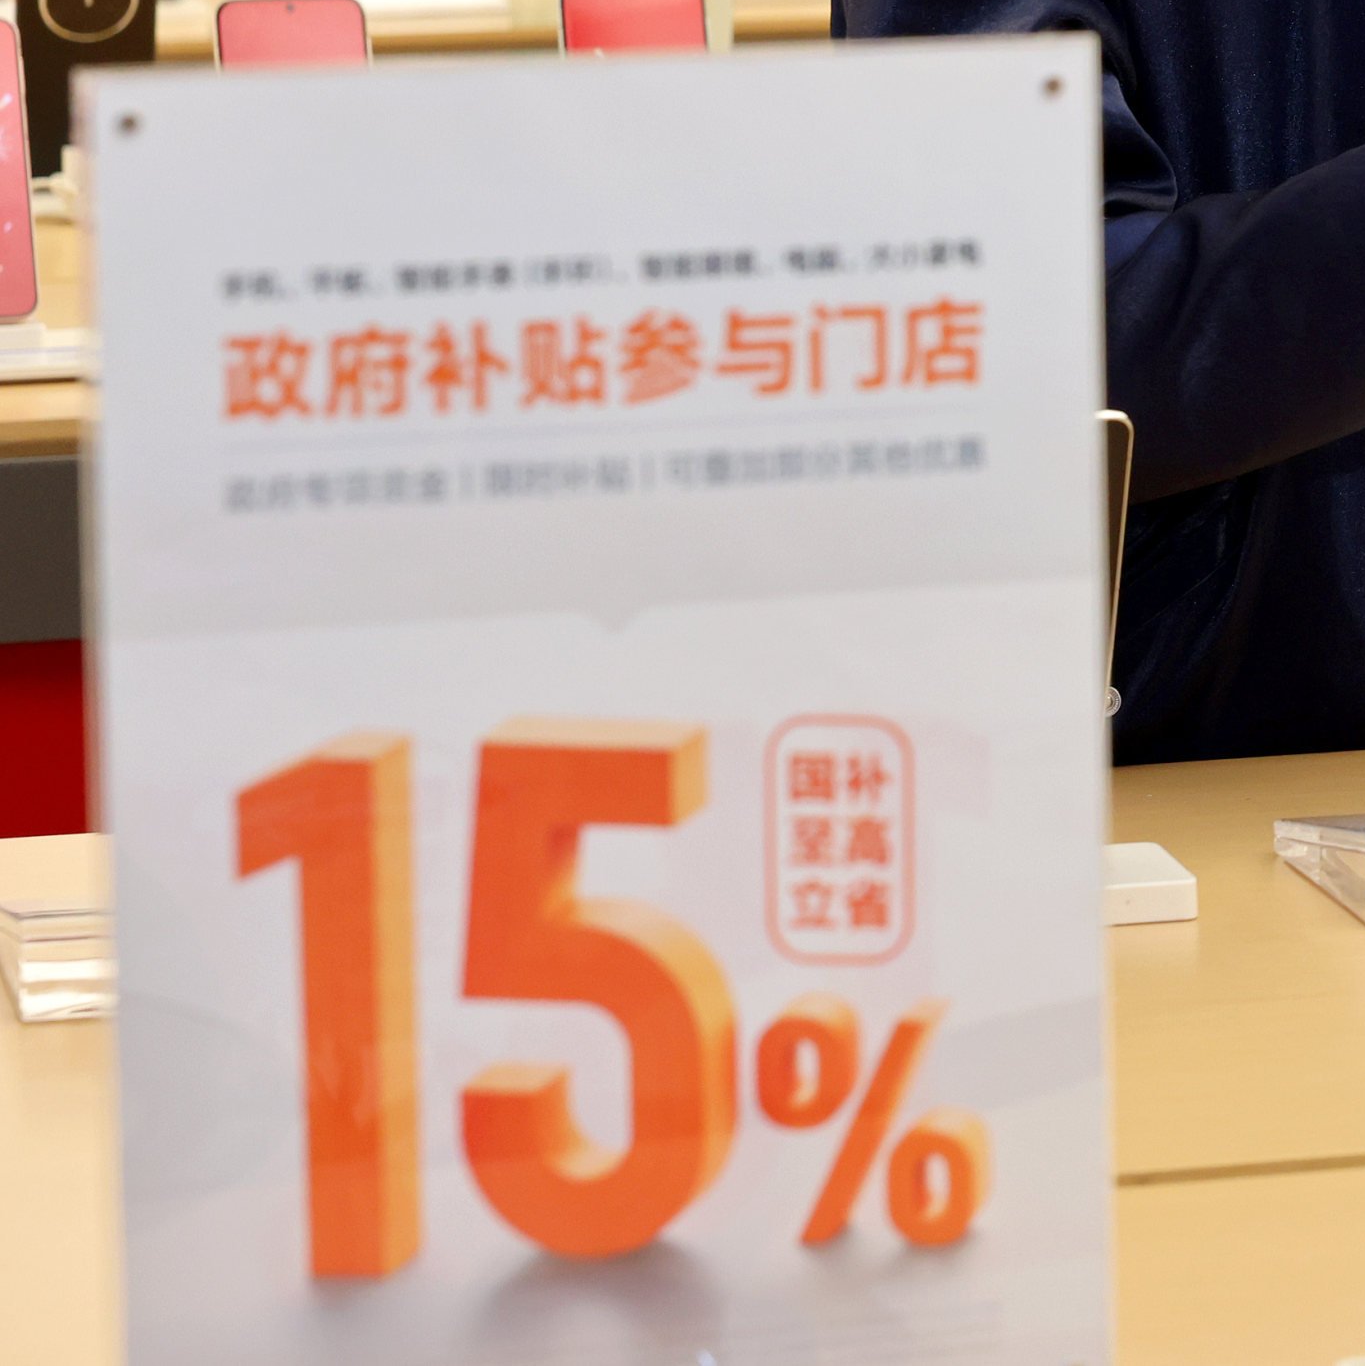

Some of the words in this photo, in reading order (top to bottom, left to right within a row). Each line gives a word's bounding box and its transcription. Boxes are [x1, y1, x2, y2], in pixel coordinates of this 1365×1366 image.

[222, 295, 984, 421] 政府补贴参与门店
[788, 751, 893, 803] 国补
[790, 815, 891, 867] 至高
[789, 880, 891, 930] 立省
[233, 716, 991, 1277] 15%
